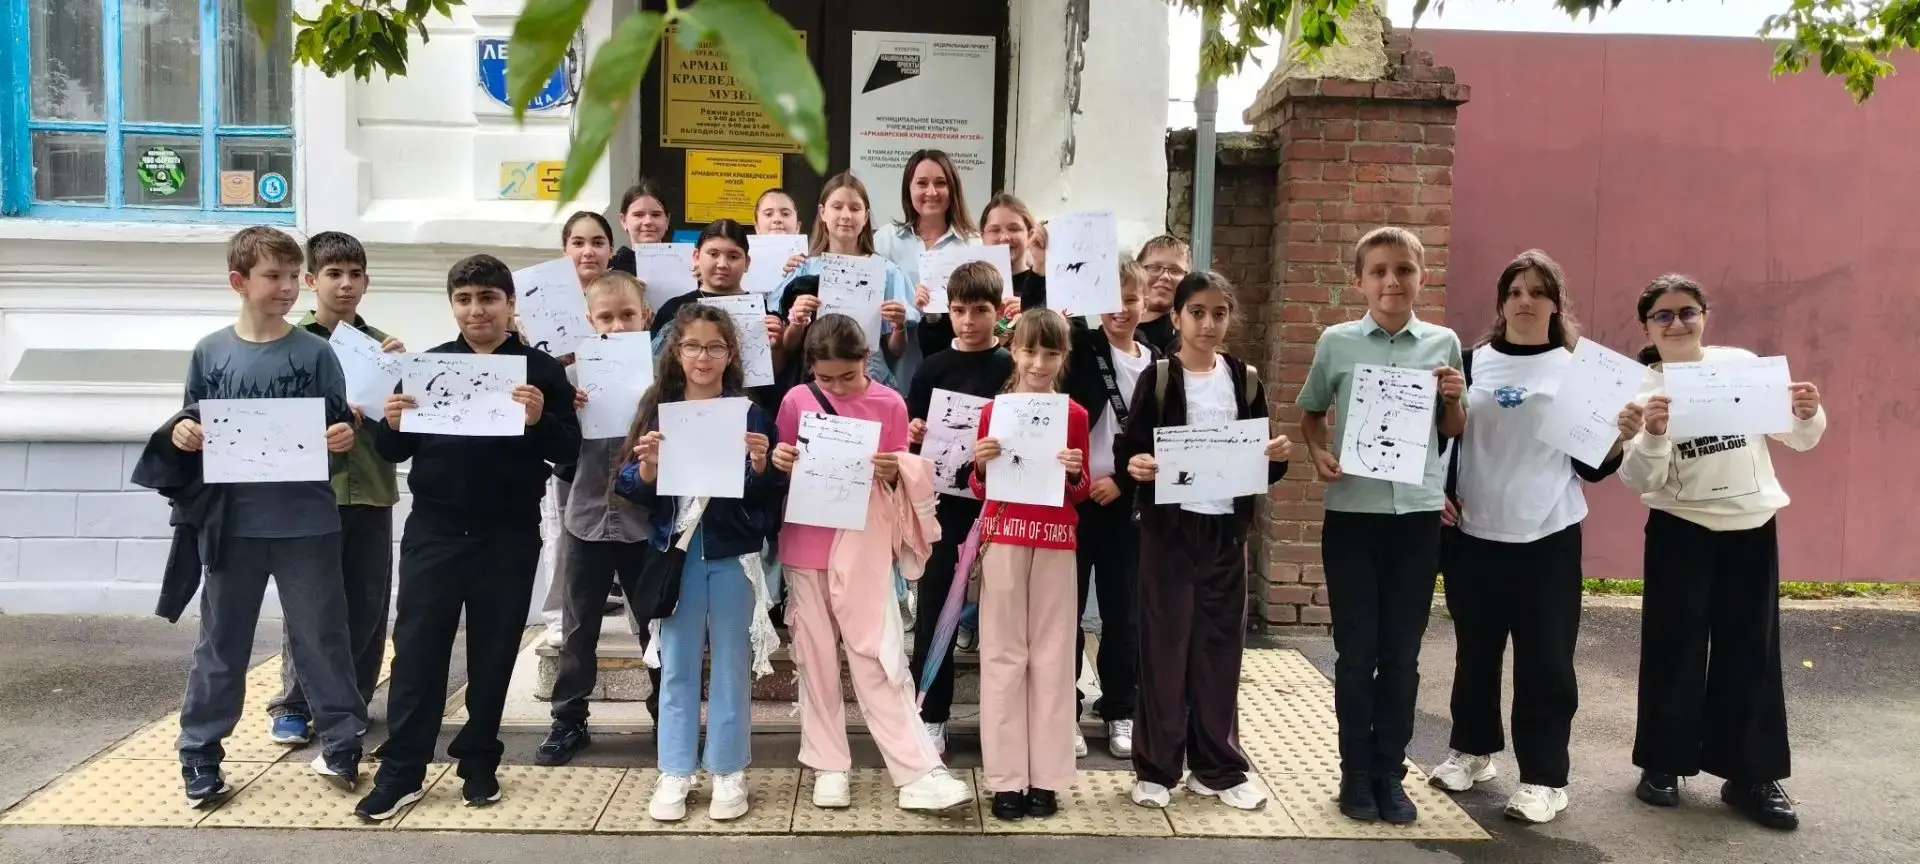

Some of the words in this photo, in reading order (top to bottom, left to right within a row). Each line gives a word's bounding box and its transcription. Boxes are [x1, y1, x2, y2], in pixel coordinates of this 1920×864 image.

[1677, 439, 1693, 452] MY
[1694, 435, 1719, 448] MOM
[1681, 448, 1697, 460] I'M
[1698, 438, 1747, 457] FABULOUS
[1003, 517, 1027, 538] WITH
[1028, 520, 1042, 540] OF
[1043, 522, 1068, 543] STARS
